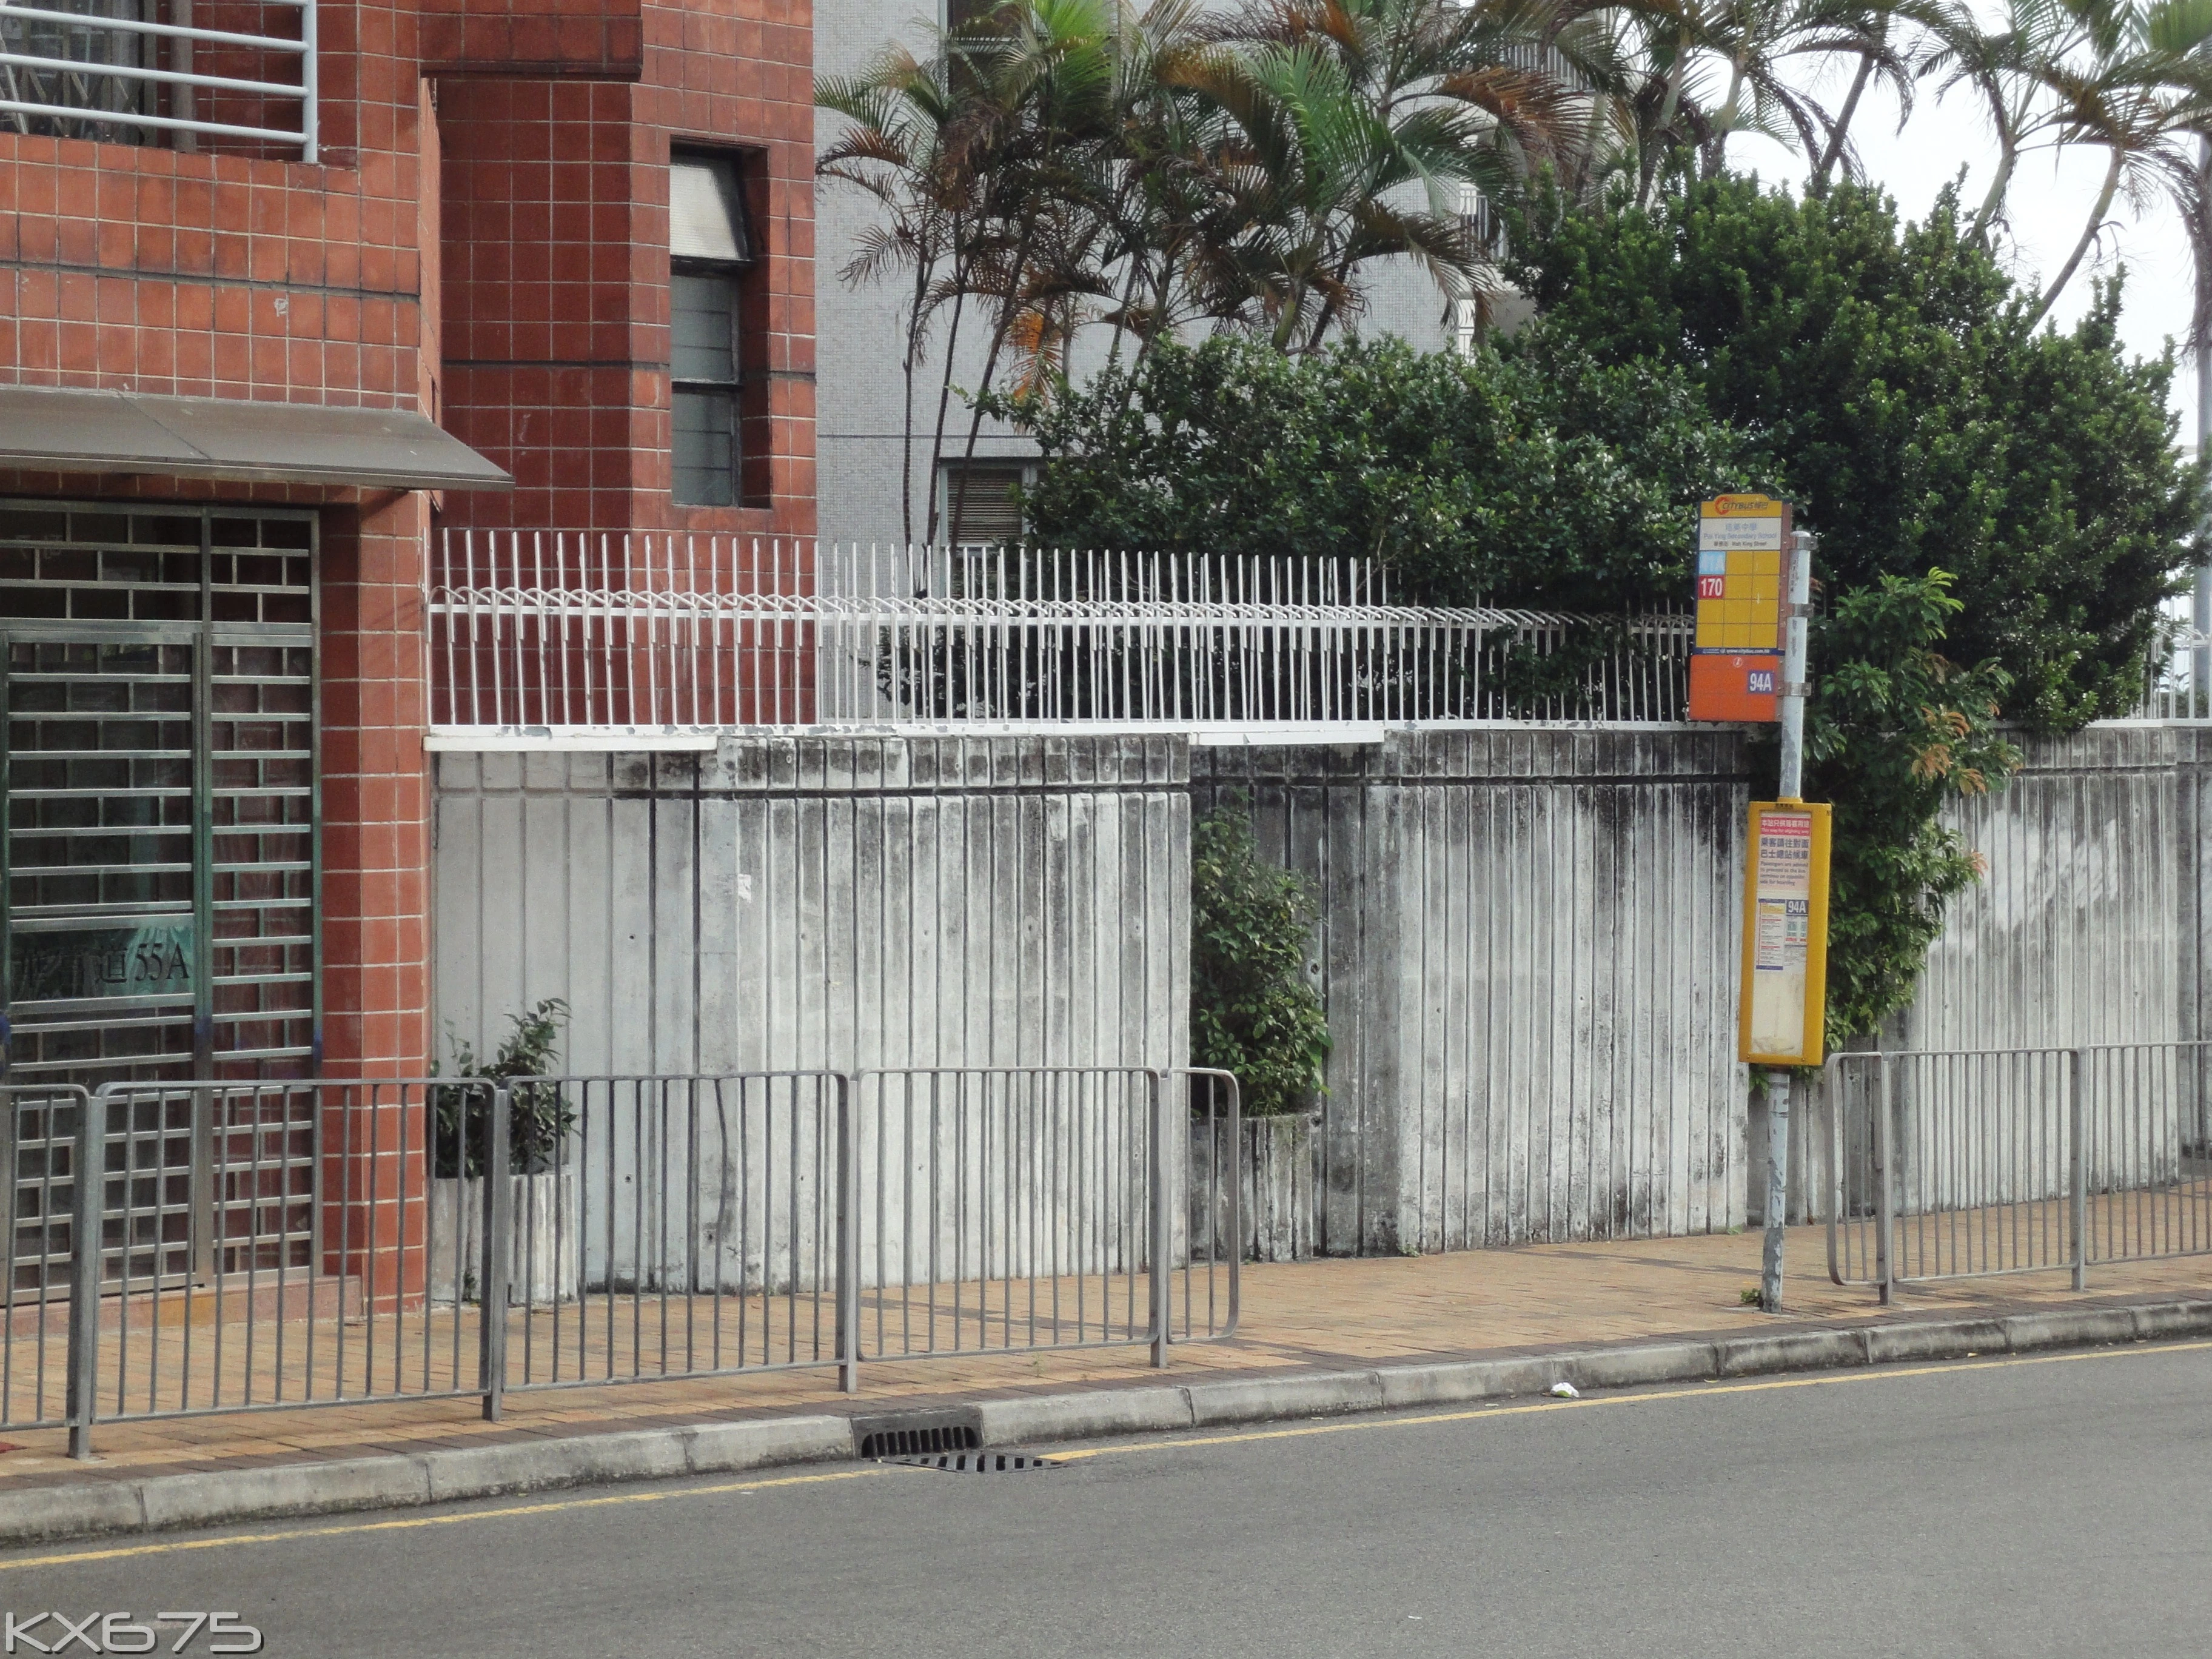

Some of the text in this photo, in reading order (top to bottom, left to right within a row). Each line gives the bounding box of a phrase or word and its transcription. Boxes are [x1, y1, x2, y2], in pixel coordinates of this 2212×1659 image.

[1701, 578, 1723, 597] 170
[1749, 673, 1772, 692] 94A
[1788, 901, 1806, 913] 94A
